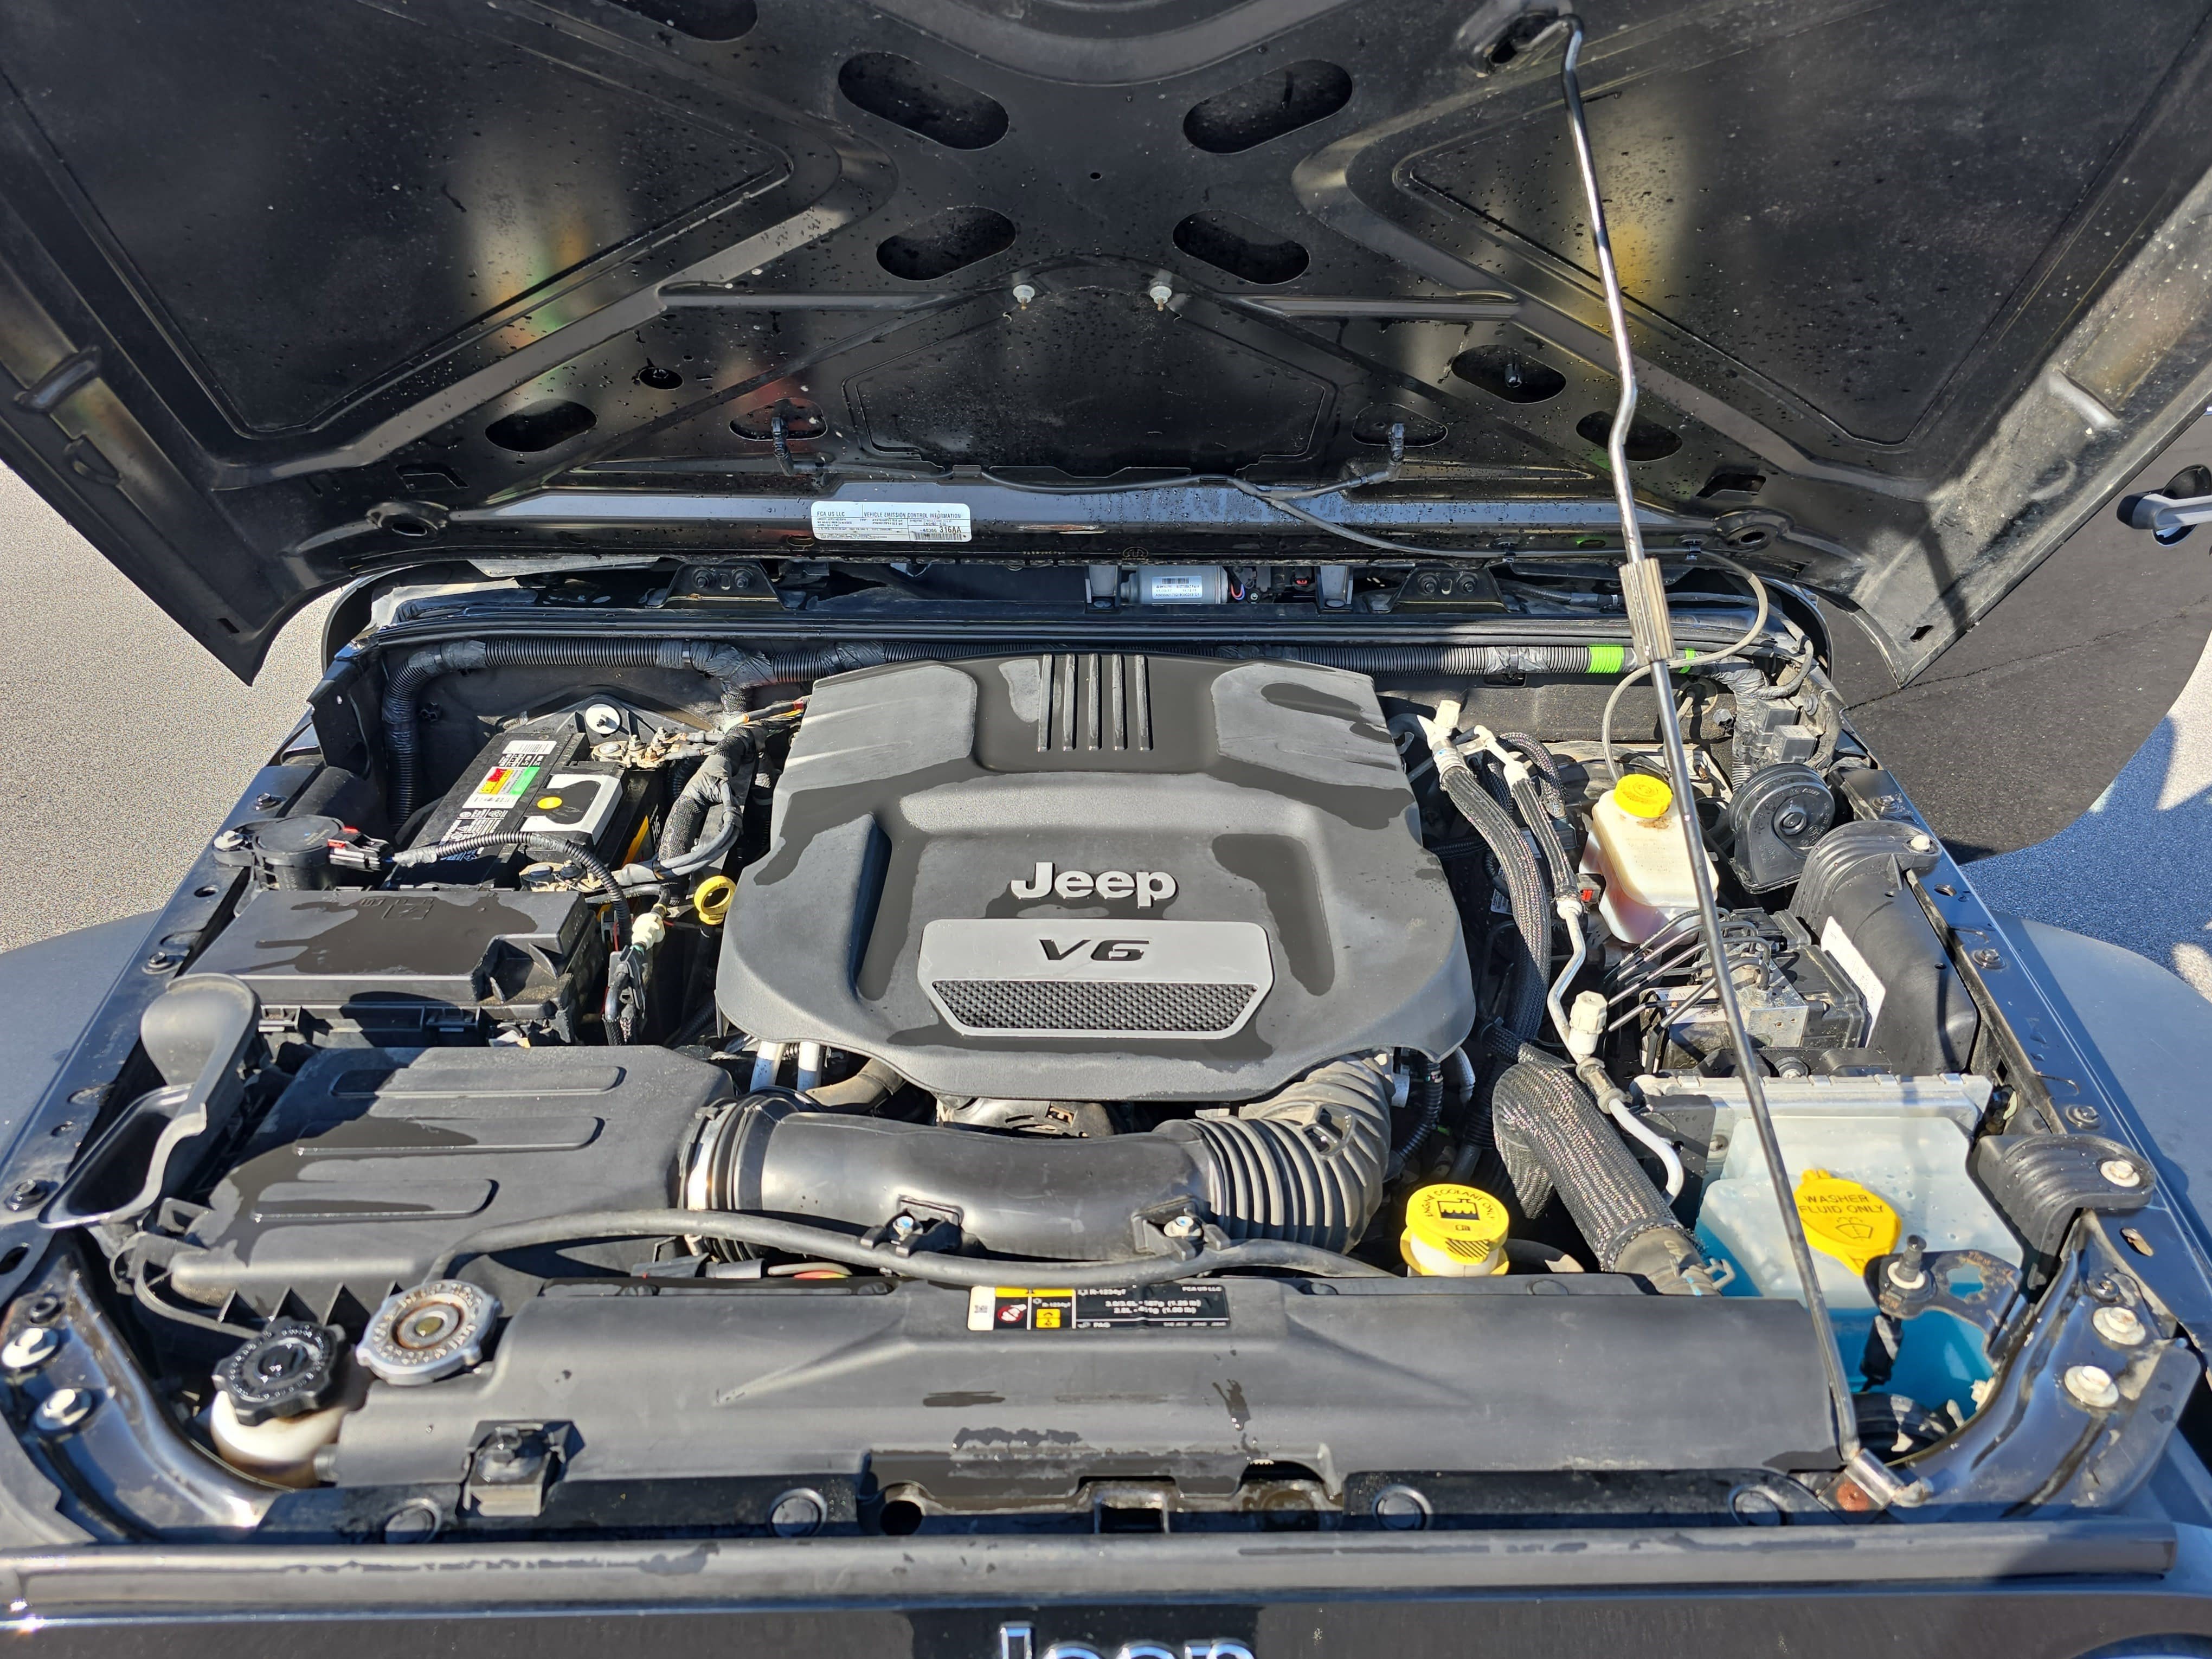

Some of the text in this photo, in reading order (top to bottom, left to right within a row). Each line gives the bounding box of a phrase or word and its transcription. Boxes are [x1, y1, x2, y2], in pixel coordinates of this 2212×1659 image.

[1011, 862, 1176, 908] Jeep
[1039, 939, 1150, 961] V6
[1434, 1188, 1483, 1201] COOLANT
[1804, 1194, 1870, 1203] WASHER
[1798, 1205, 1883, 1214] FLUID ONLY
